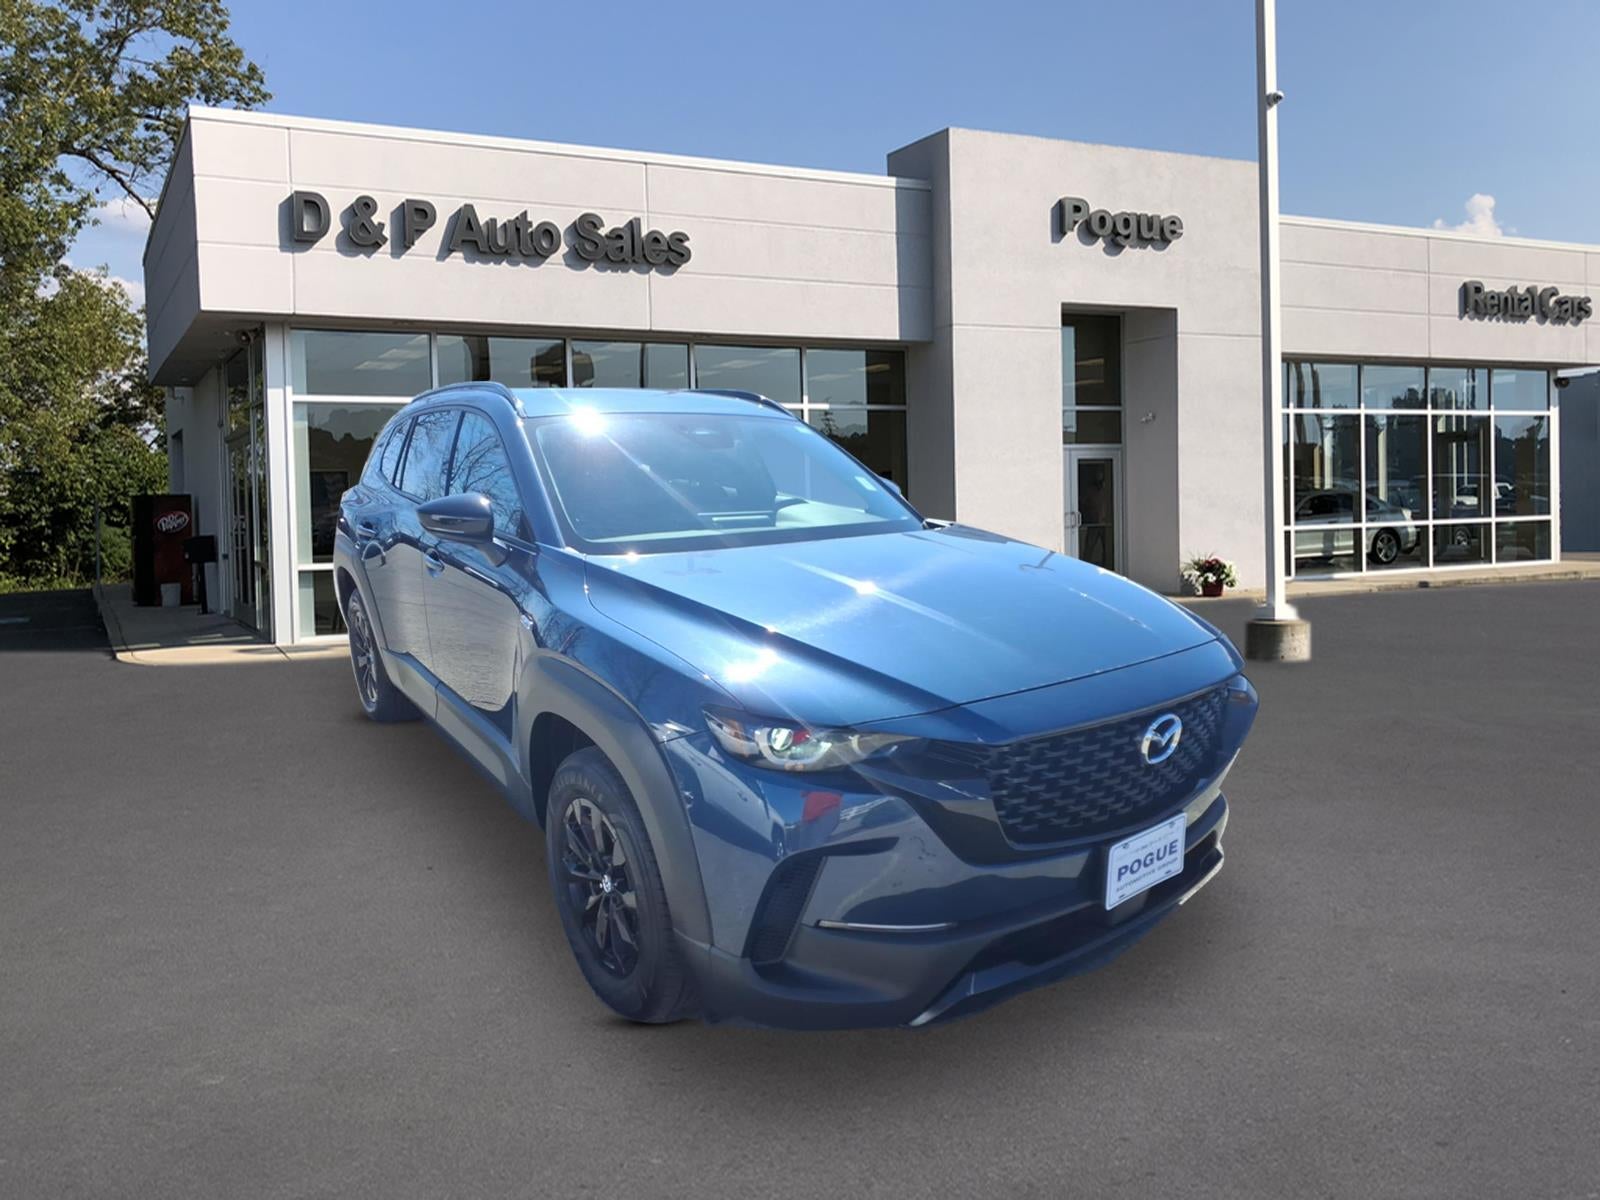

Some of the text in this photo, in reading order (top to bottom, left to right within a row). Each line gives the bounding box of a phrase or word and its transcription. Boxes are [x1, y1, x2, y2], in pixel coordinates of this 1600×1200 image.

[292, 190, 692, 267] D & P Auto Sales
[1058, 196, 1184, 247] Pogue
[1462, 280, 1592, 321] Rental Cars
[1117, 839, 1179, 882] POGUE
